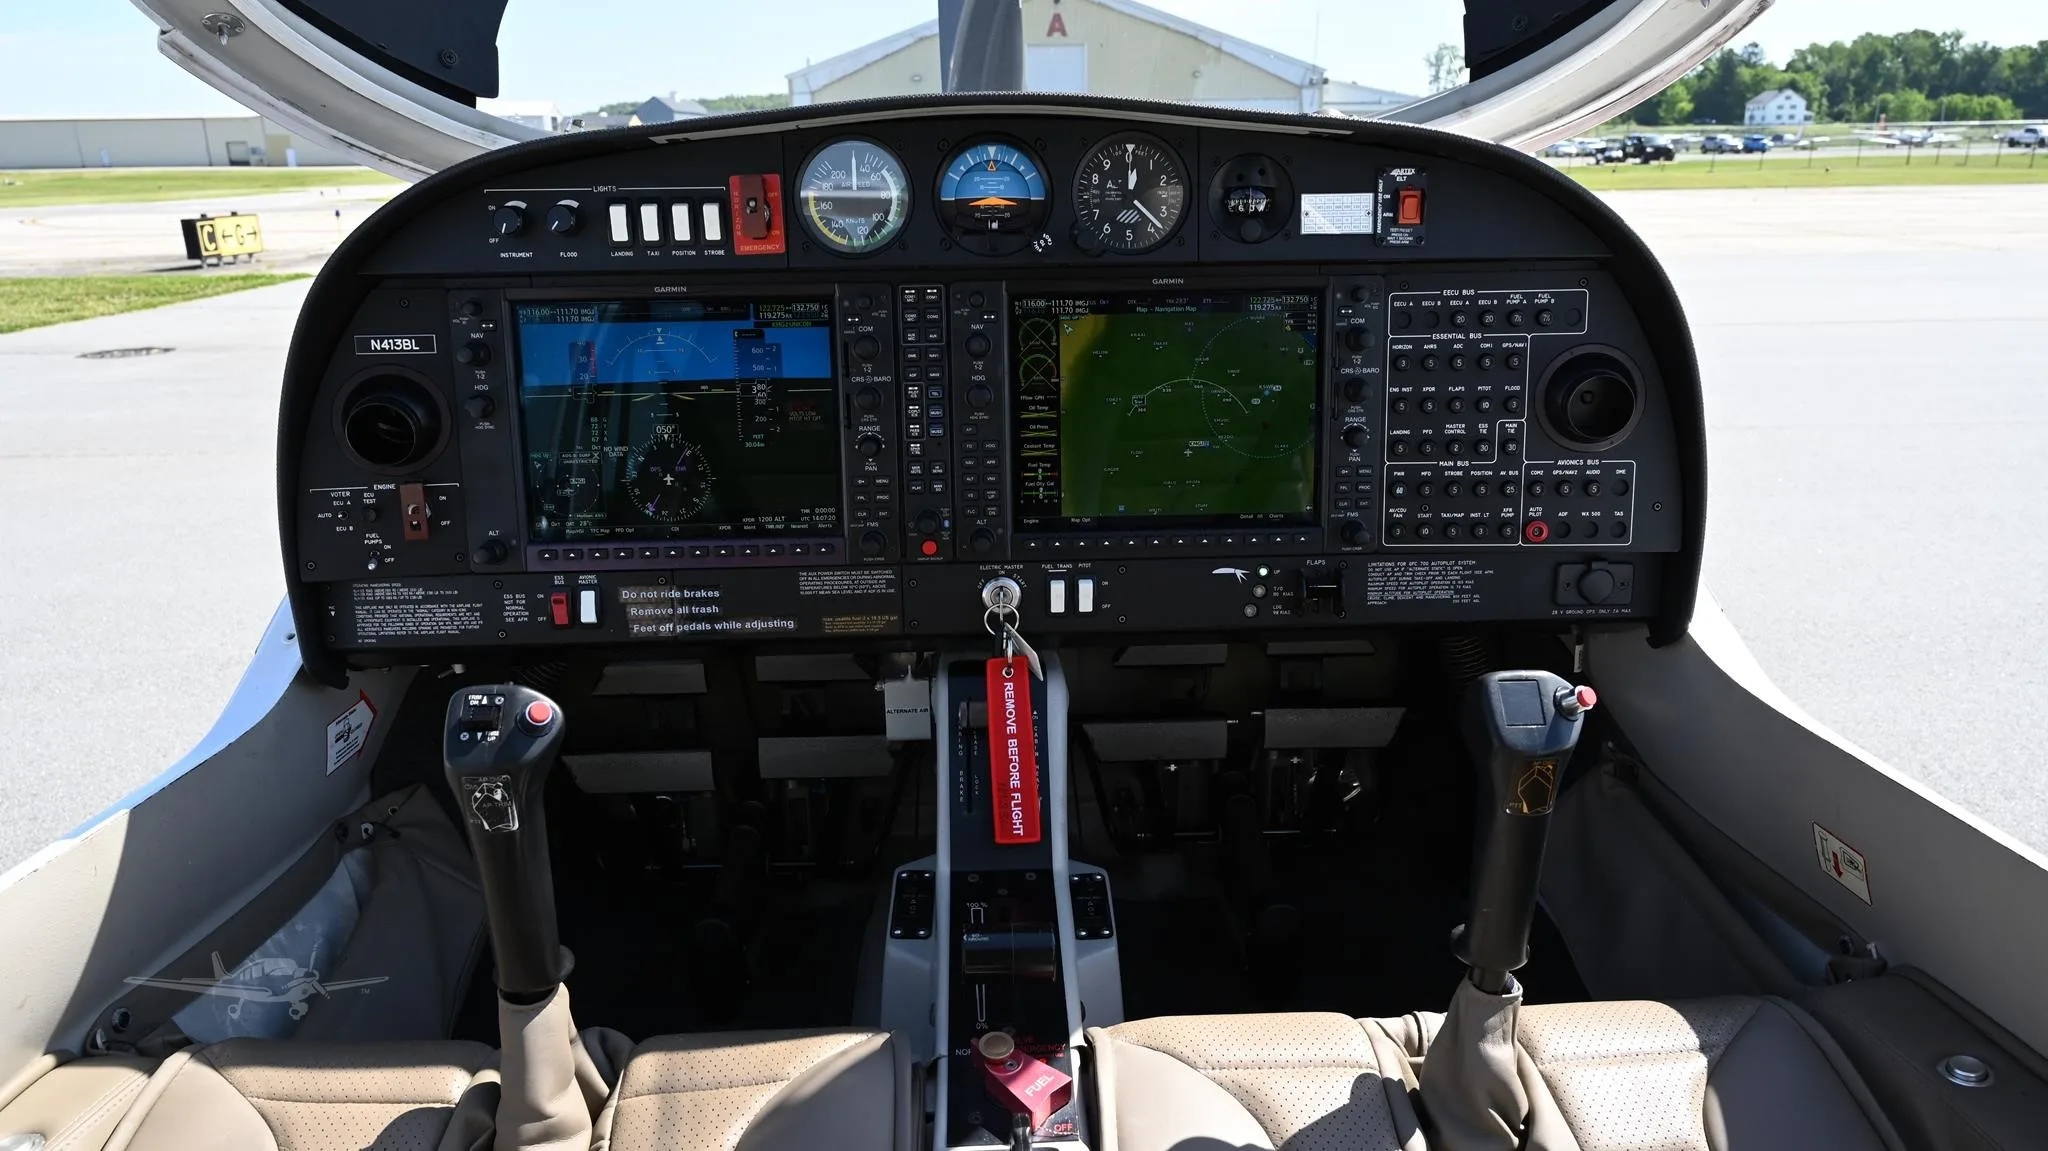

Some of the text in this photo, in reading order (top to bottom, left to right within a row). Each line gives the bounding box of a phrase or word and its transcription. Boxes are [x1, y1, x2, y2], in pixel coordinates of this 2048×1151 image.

[1046, 12, 1068, 37] A
[860, 164, 870, 172] 40
[1103, 160, 1110, 170] 9
[831, 170, 846, 179] 200
[1092, 174, 1098, 184] 8
[1160, 175, 1166, 186] 2
[880, 191, 890, 199] 80
[820, 201, 832, 210] 160
[1093, 210, 1099, 220] 7
[1160, 206, 1167, 217] 3
[872, 213, 884, 221] 100
[831, 220, 844, 228] 140
[1103, 223, 1110, 234] 6
[1148, 223, 1155, 233] 4
[857, 226, 869, 234] 120
[1126, 230, 1133, 240] 5
[202, 225, 217, 250] C
[371, 339, 420, 350] N413BL
[622, 589, 720, 599] Do not ride brakes
[630, 605, 719, 616] Remove all trash
[634, 620, 794, 633] Feet off pedals while adjusting
[1004, 682, 1023, 836] REMOVE BEFORE FLIGHT
[1024, 1074, 1055, 1097] FUEL
